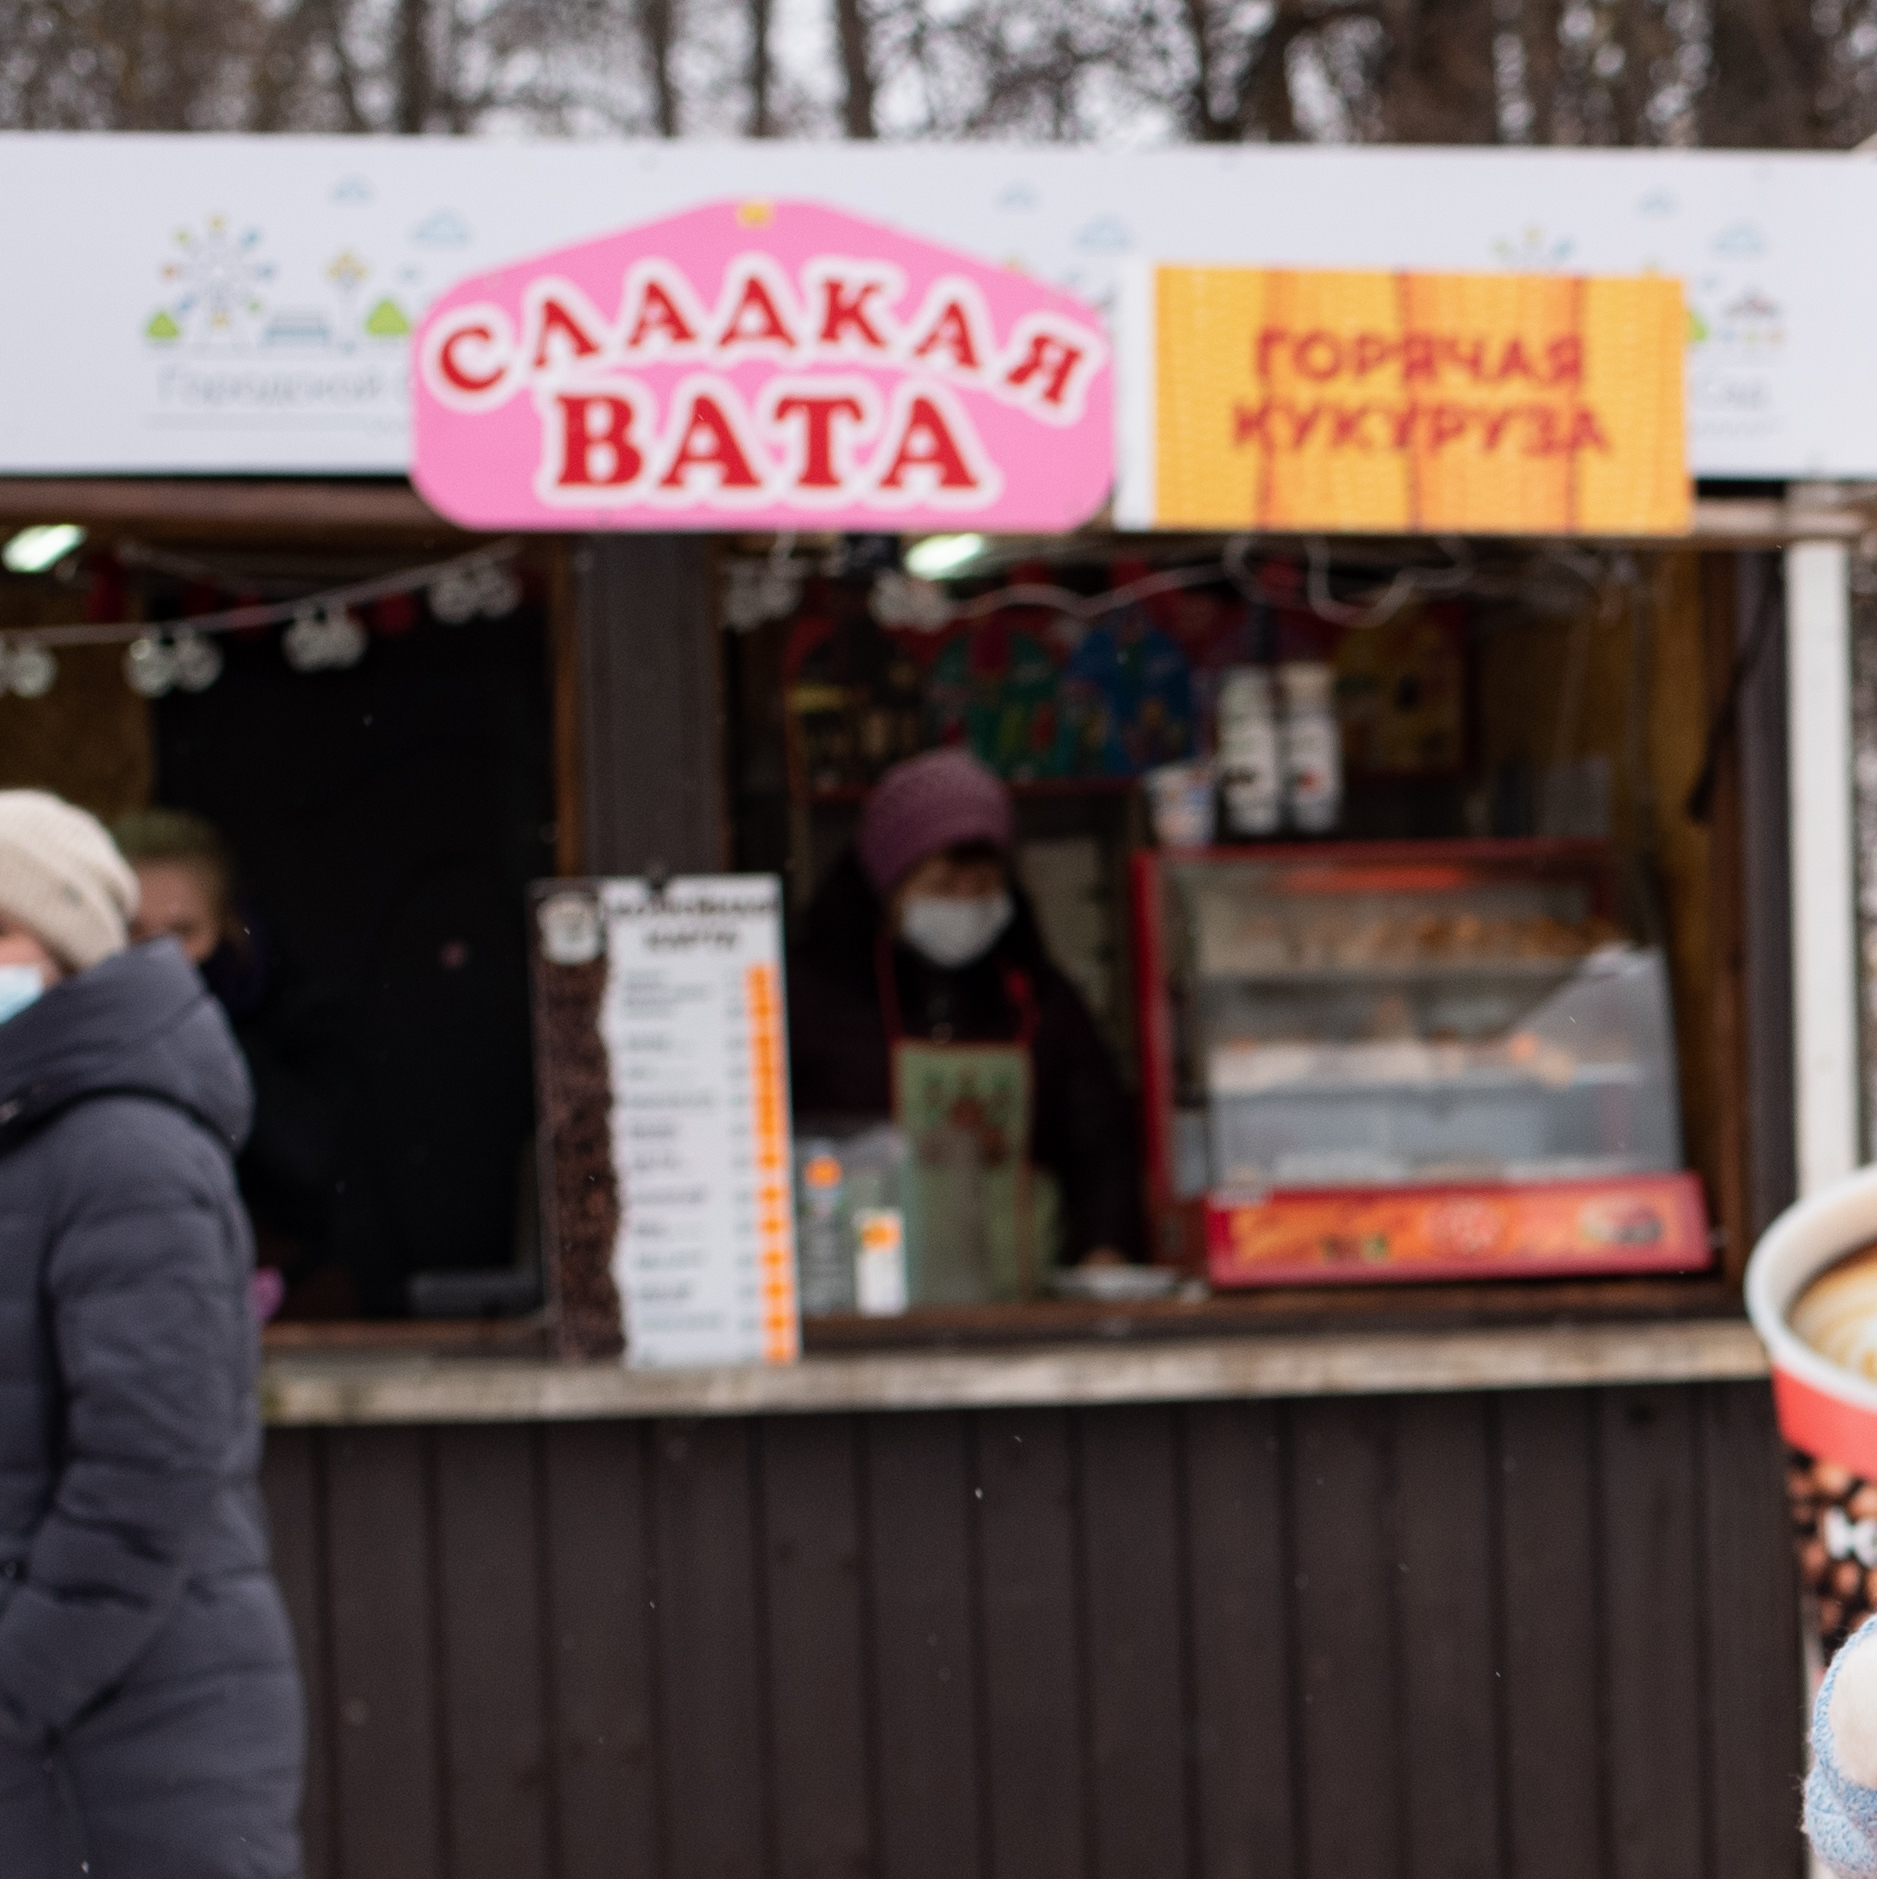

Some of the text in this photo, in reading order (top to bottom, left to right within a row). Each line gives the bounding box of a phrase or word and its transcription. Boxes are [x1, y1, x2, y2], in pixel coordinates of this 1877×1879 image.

[438, 275, 1086, 407] СЛАДКАЯ
[1254, 328, 1584, 386] ГОРЯЧАЯ
[554, 394, 980, 491] ВАТА
[1231, 401, 1616, 459] КУКУРУЗА
